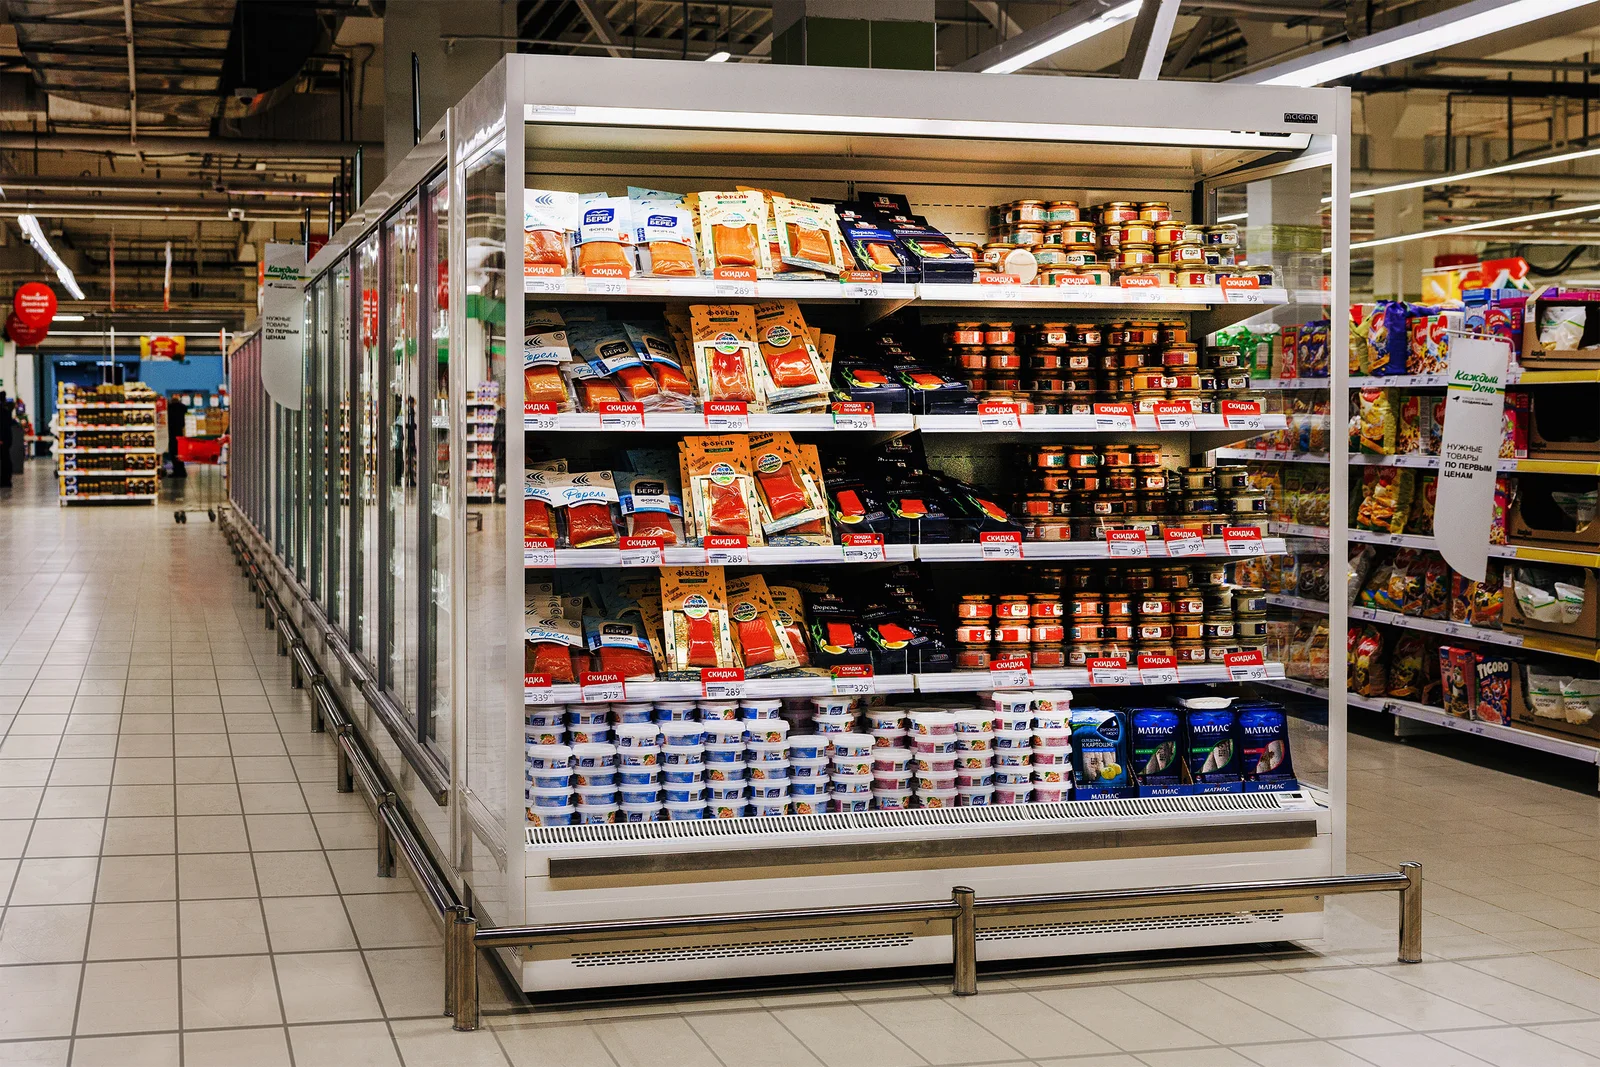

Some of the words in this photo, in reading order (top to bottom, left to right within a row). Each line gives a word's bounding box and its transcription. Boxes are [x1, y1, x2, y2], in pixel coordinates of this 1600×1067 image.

[268, 265, 300, 274] Каждый
[523, 266, 554, 274] СКИДКА
[591, 268, 622, 276] СКИДКА
[280, 273, 298, 281] День
[720, 270, 751, 278] СКИДКА
[985, 275, 1015, 284] СКИДКА
[1061, 276, 1090, 285] СКИДКА
[1126, 277, 1154, 286] СКИДКА
[1226, 278, 1254, 287] СКИДКА
[544, 283, 560, 292] 339
[605, 284, 621, 292] 379
[734, 287, 749, 295] 289
[1247, 294, 1258, 302] 99
[604, 346, 627, 357] БЕРЕГ
[1454, 370, 1498, 384] Каждый
[1472, 382, 1496, 394] День
[606, 404, 637, 412] СКИДКА
[710, 404, 740, 412] СКИДКА
[985, 406, 1013, 414] СКИДКА
[1100, 406, 1128, 414] СКИДКА
[1228, 402, 1255, 411] СКИДКА
[538, 420, 554, 429] 339
[621, 419, 636, 428] 379
[727, 421, 742, 429] 289
[852, 420, 868, 428] 329
[1002, 420, 1013, 428] 99
[1179, 420, 1190, 428] 99
[1248, 420, 1259, 428] 99
[749, 432, 774, 444] ОРЕЛЬ
[701, 440, 735, 448] ФОРЕЛЬ
[1447, 443, 1483, 453] НУЖНЫЕ
[1446, 452, 1479, 462] ТОВАРЫ
[1445, 461, 1456, 469] ПО
[1458, 462, 1492, 472] ПЕРВЫМ
[1444, 470, 1473, 479] ЦЕНАМ
[562, 488, 606, 501] Форель
[986, 534, 1015, 542] СКИДКА
[1112, 532, 1139, 540] СКИДКА
[1228, 530, 1255, 538] СКИДКА
[711, 538, 740, 546] СКИДКА
[1004, 548, 1014, 556] 99
[1130, 547, 1142, 555] 99
[1188, 544, 1199, 552] 99
[1248, 545, 1259, 553] 99
[533, 555, 549, 564] 339
[640, 554, 655, 564] 379
[727, 555, 743, 563] 289
[864, 552, 877, 560] 329
[526, 627, 570, 641] Форель
[1144, 656, 1170, 664] СКИДКА
[1230, 654, 1257, 663] СКИДКА
[996, 661, 1024, 669] СКИДКА
[1093, 660, 1121, 668] СКИДКА
[1476, 661, 1509, 680] TIGORO
[1114, 675, 1124, 683] 99
[1162, 674, 1172, 682] 99
[1250, 671, 1261, 679] 99
[524, 676, 544, 684] ИДКА
[854, 684, 869, 692] 329
[725, 688, 740, 697] 289
[532, 694, 548, 702] 339
